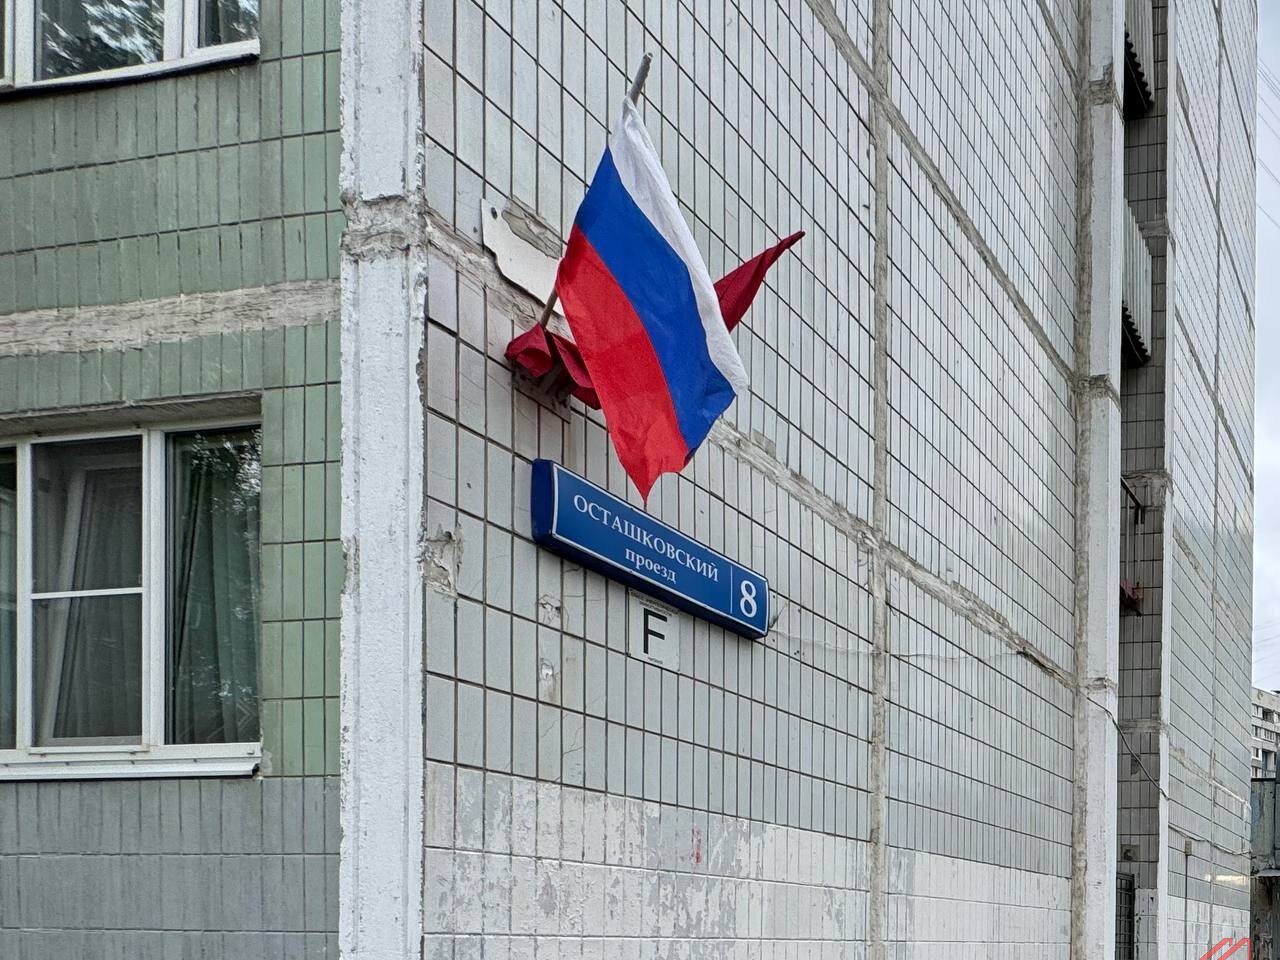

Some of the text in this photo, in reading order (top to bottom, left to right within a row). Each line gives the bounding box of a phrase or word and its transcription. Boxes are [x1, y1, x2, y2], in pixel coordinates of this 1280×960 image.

[573, 494, 719, 582] ОСТАШКОВСКИЙ
[625, 549, 677, 584] проезд
[739, 580, 757, 618] 8
[643, 607, 667, 654] F
